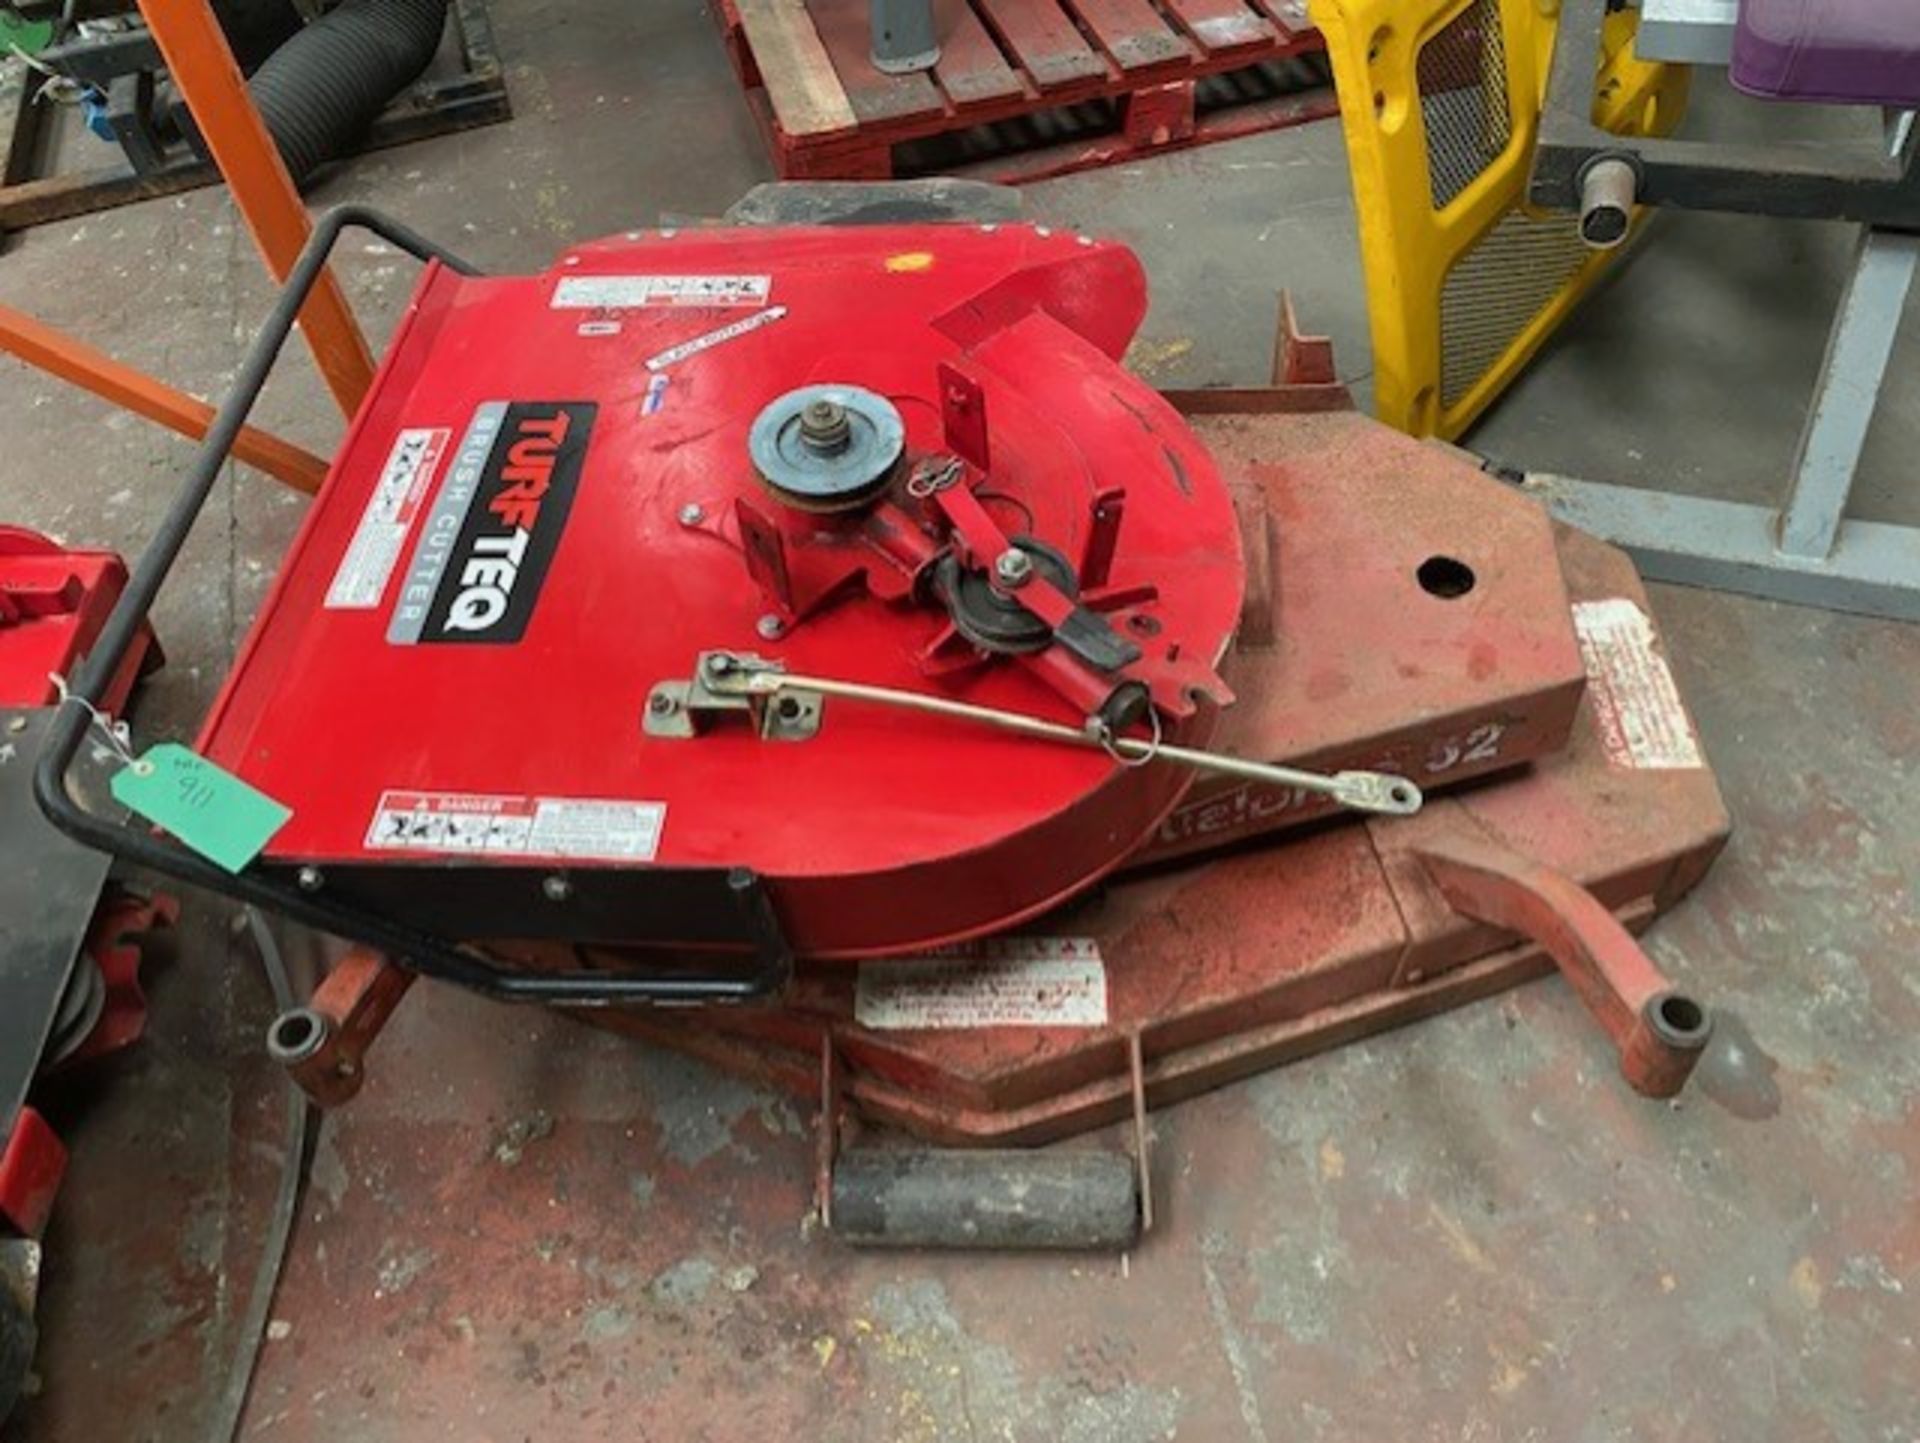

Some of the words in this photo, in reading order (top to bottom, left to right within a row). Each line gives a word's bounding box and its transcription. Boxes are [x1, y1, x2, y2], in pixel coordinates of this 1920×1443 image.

[448, 417, 498, 500] BRUSH
[400, 516, 457, 620] CUTTER
[443, 410, 571, 632] TURFTEQ
